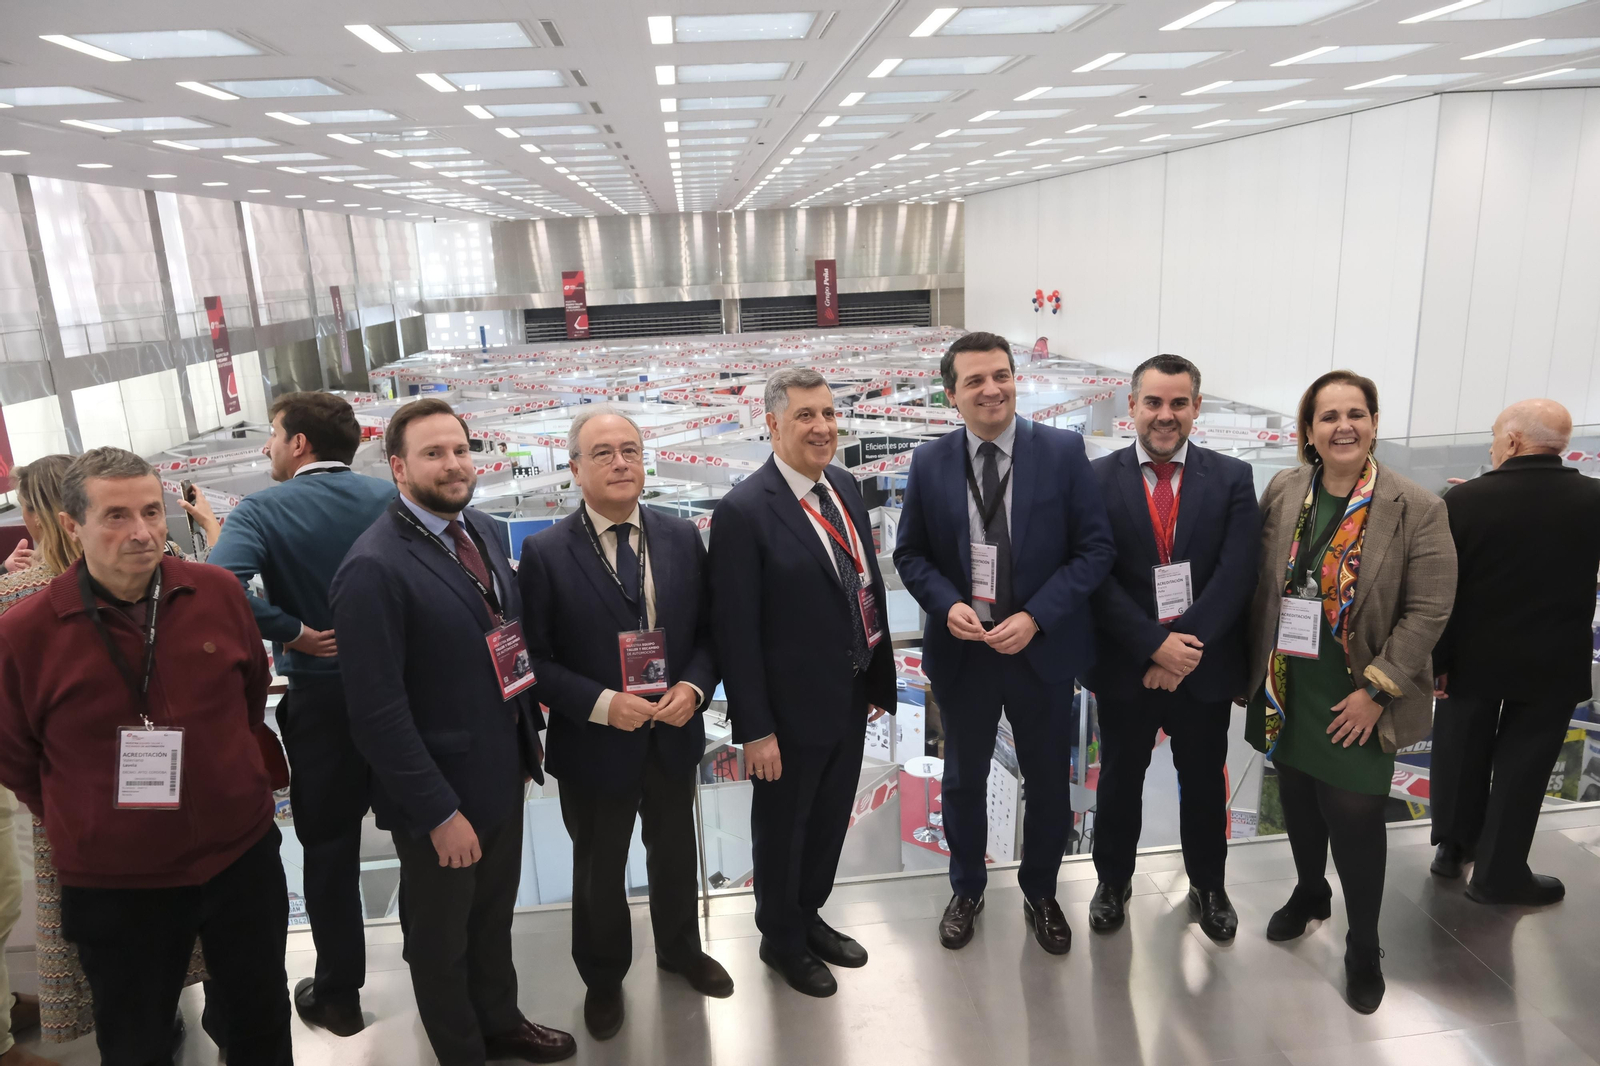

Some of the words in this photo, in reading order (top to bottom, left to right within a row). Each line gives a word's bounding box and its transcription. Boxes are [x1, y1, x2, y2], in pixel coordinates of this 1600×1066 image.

[824, 286, 832, 307] Grupo
[865, 442, 897, 451] Eficientes
[898, 442, 909, 450] por
[1157, 578, 1184, 587] ACREDITACIÓN
[1281, 612, 1312, 620] ACREDITACIÓN
